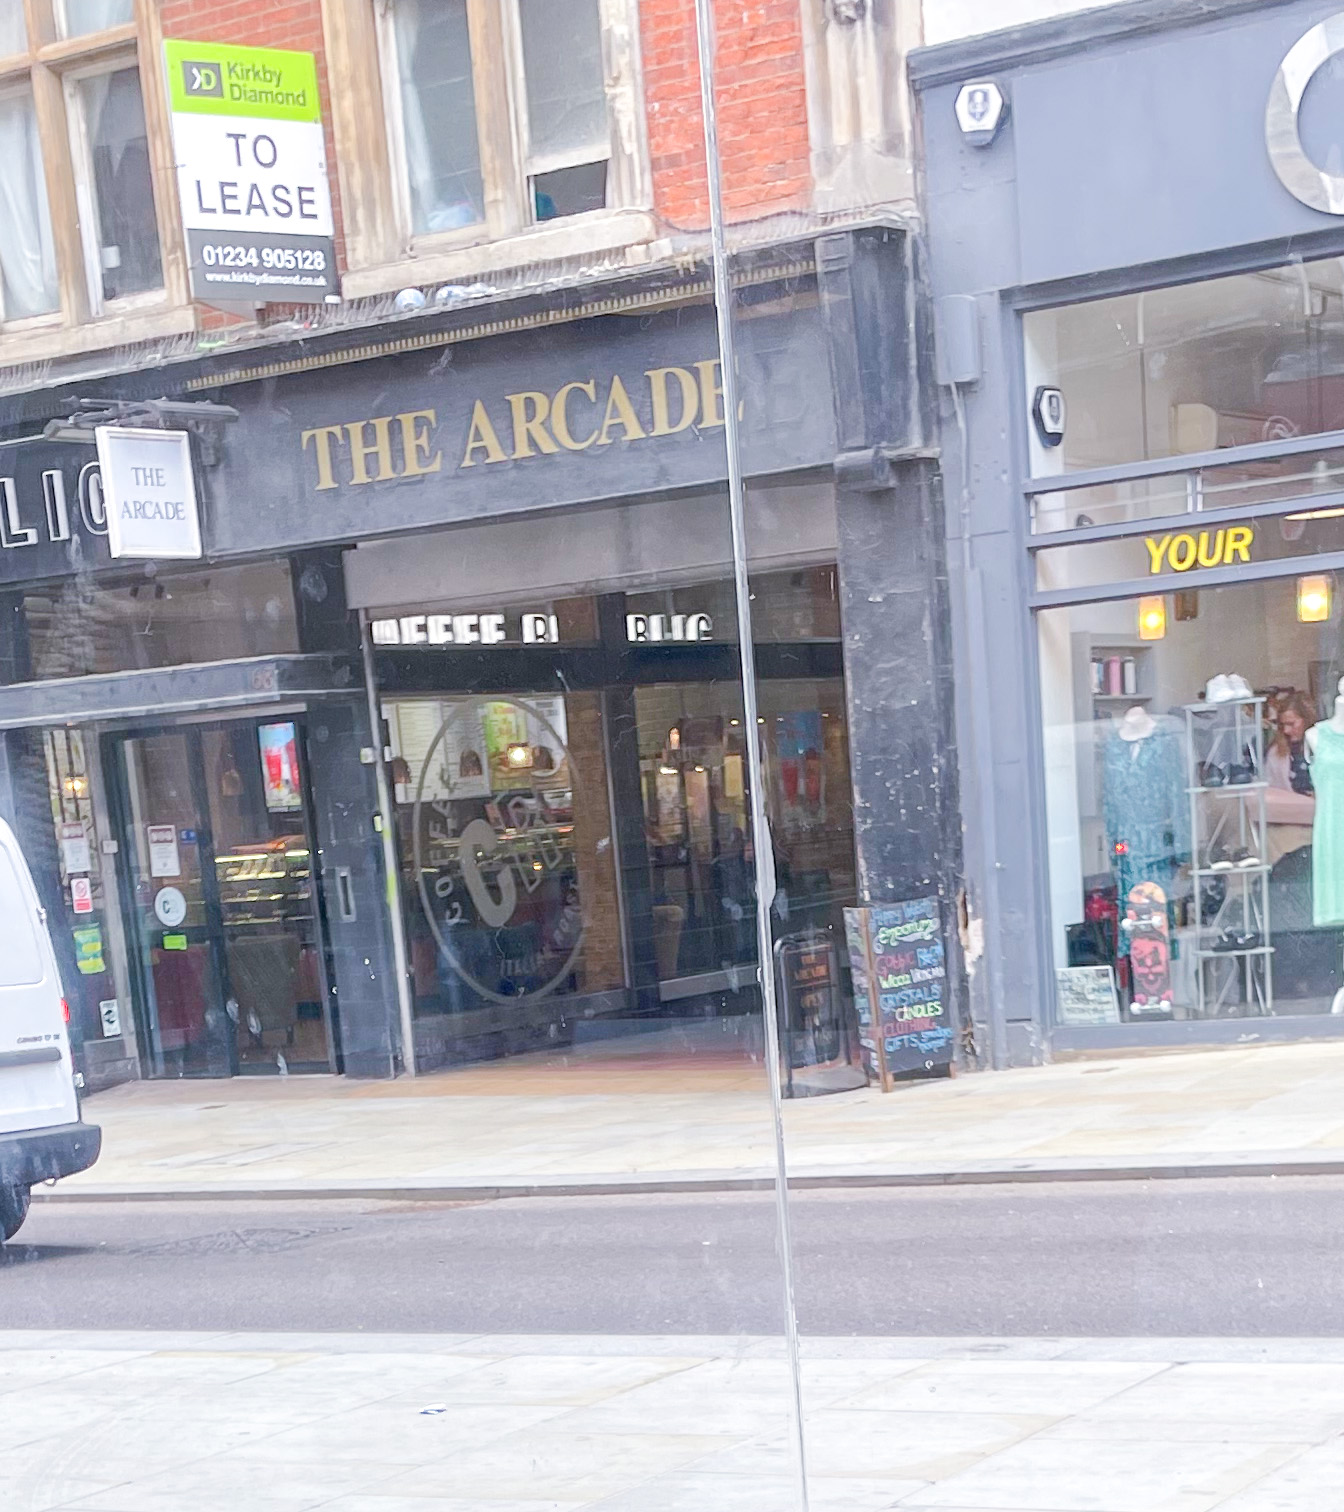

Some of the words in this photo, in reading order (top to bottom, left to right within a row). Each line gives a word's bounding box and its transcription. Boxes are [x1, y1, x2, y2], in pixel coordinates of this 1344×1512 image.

[227, 61, 282, 88] Kirkby
[229, 83, 306, 106] Diamond
[226, 132, 278, 168] TO
[195, 179, 318, 219] LEASE
[202, 245, 258, 268] 01234
[261, 247, 326, 271] 905128
[302, 410, 442, 490] THE
[459, 358, 746, 468] ARCADE
[130, 466, 166, 487] THE
[120, 500, 186, 521] ARCADE
[1145, 526, 1254, 573] YOUR
[896, 1001, 944, 1021] CANDLES
